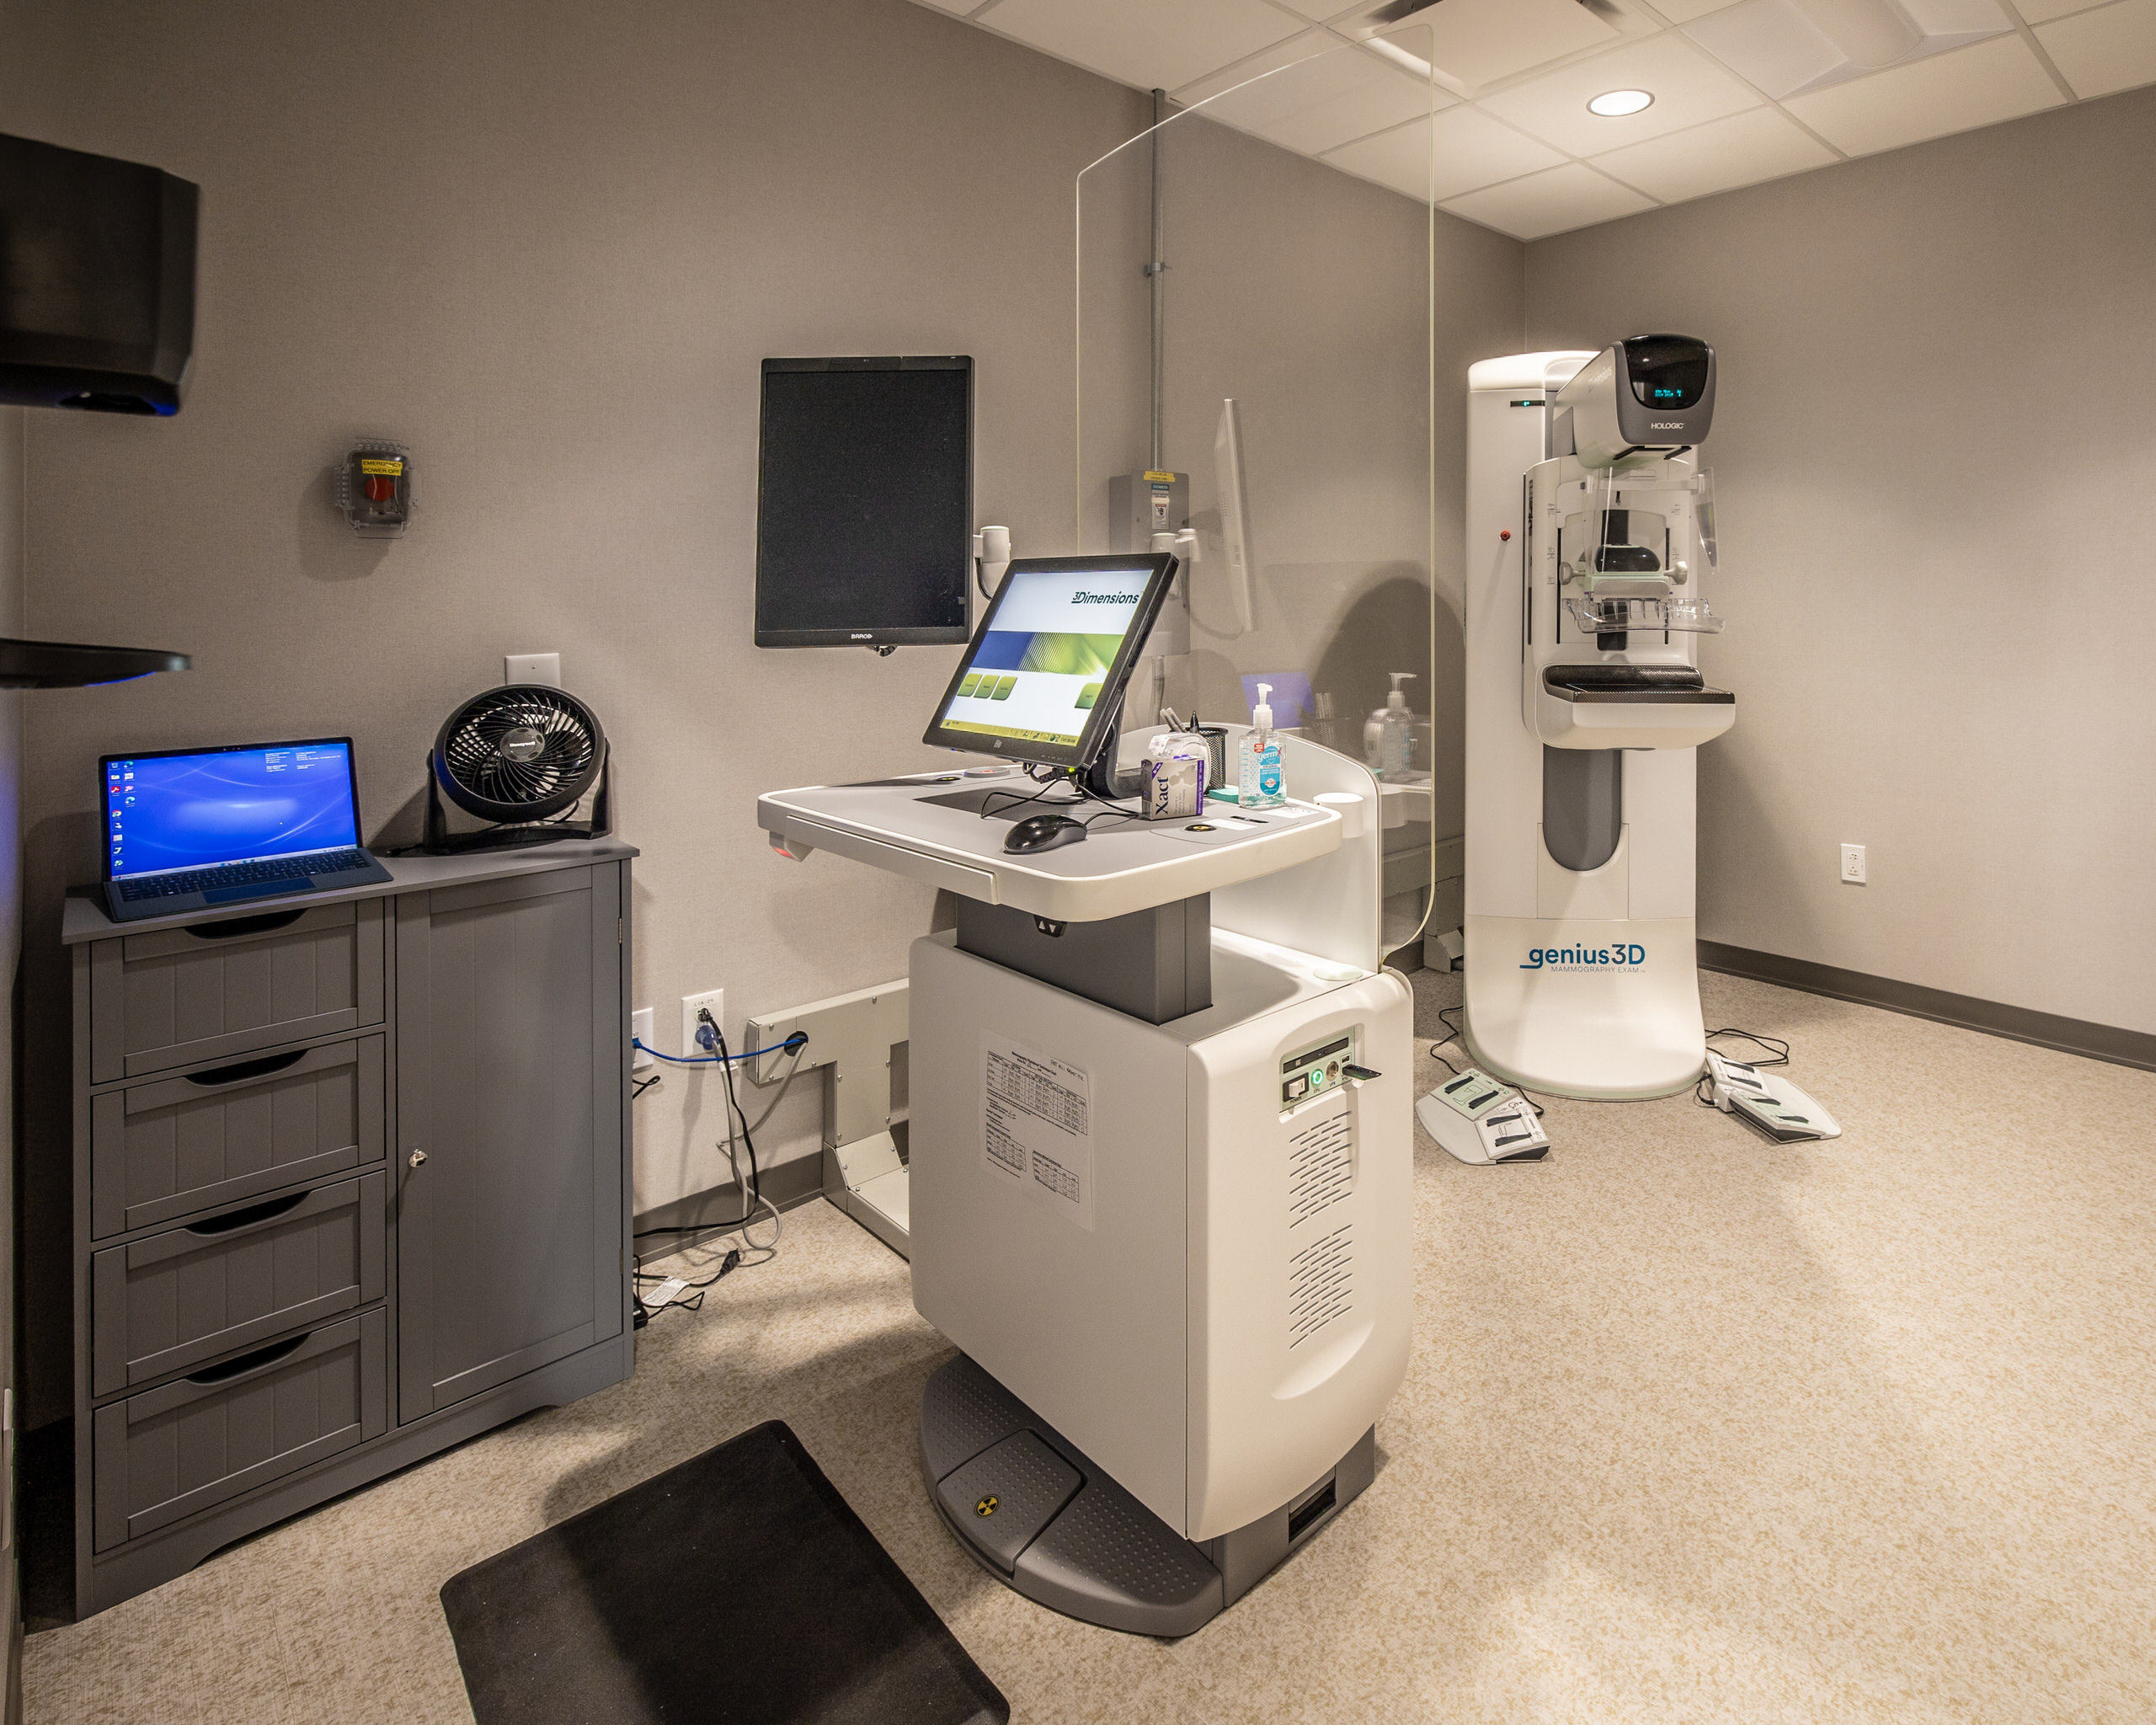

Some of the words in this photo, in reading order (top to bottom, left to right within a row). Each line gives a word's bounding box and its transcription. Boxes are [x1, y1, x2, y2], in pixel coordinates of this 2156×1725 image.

[1070, 591, 1139, 604] 3Dimensions
[1155, 777, 1169, 815] Xact
[1519, 943, 1646, 969] genius3D
